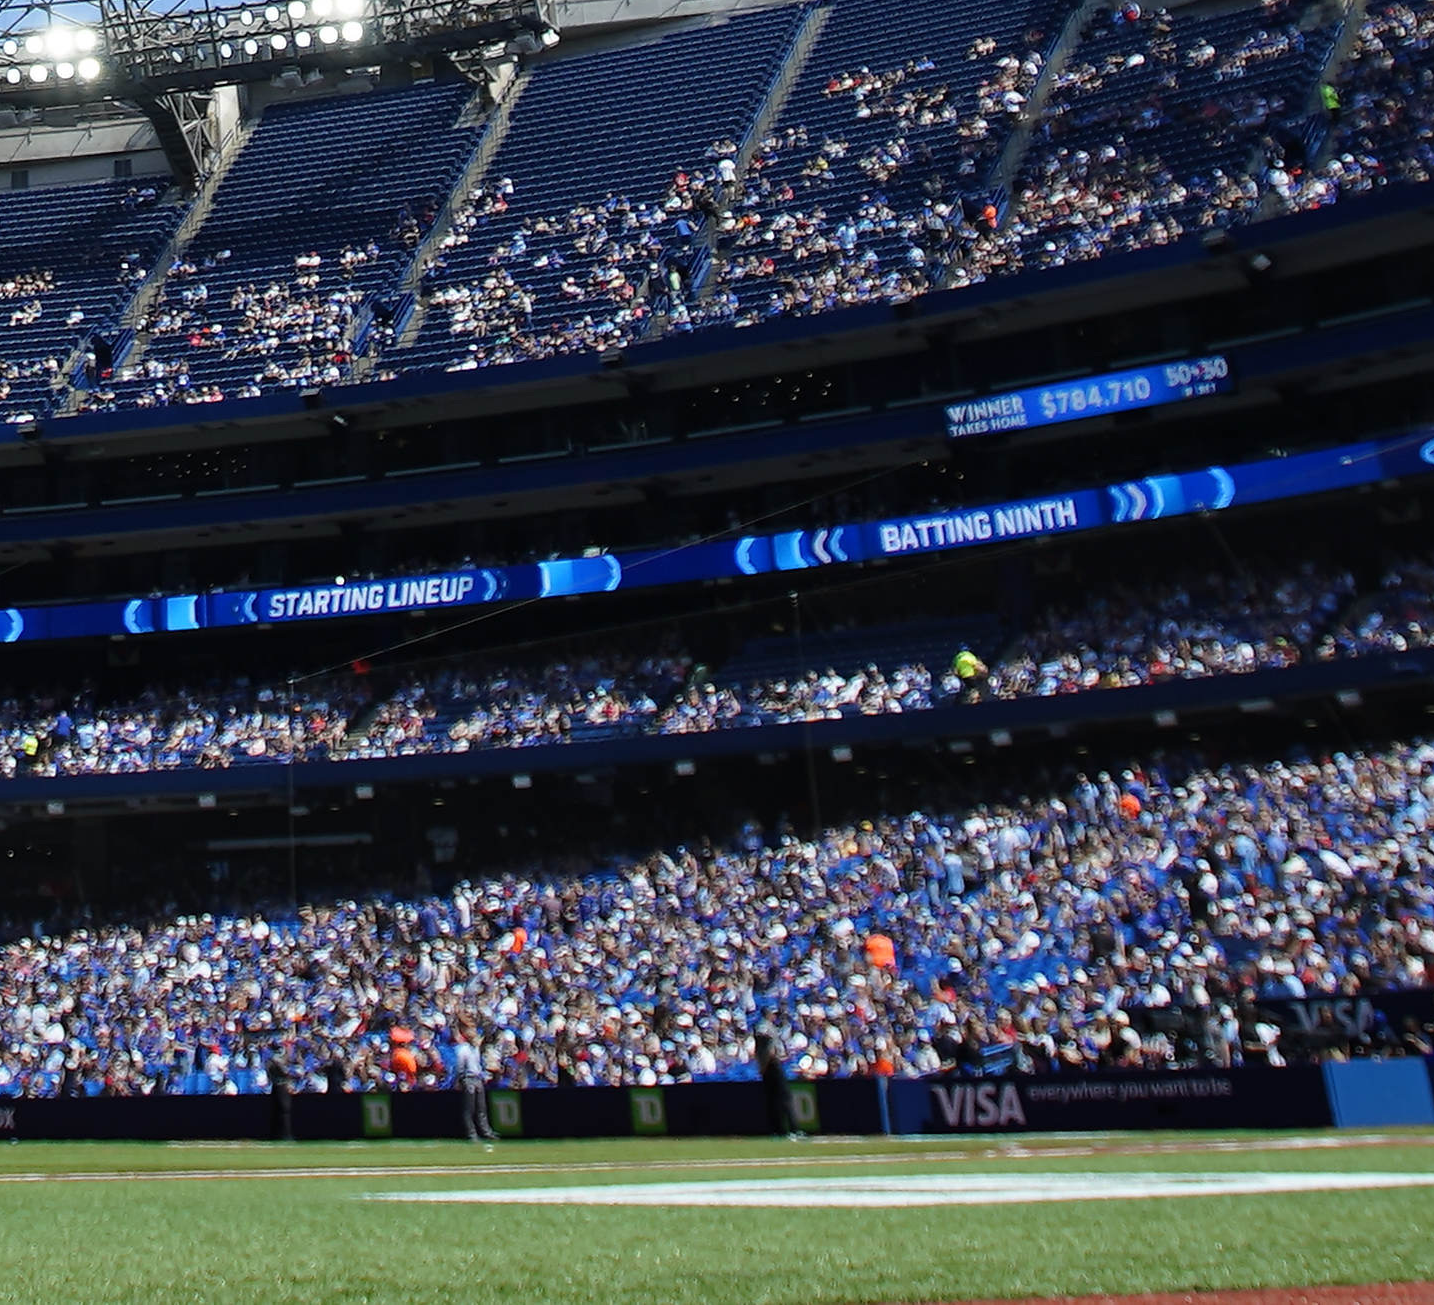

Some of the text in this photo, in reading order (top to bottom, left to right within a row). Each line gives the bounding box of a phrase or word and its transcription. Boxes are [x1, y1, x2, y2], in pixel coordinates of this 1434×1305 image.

[946, 395, 1024, 424] WINNER
[949, 415, 1027, 438] TAKES HOME
[879, 497, 1078, 552] BATTING NINTH
[268, 576, 475, 619] STARTING LINEUP
[931, 1081, 1028, 1127] VISA
[1029, 1080, 1117, 1103] everywhere
[1118, 1081, 1149, 1102] you
[1150, 1079, 1190, 1098] want
[1208, 1077, 1232, 1096] be
